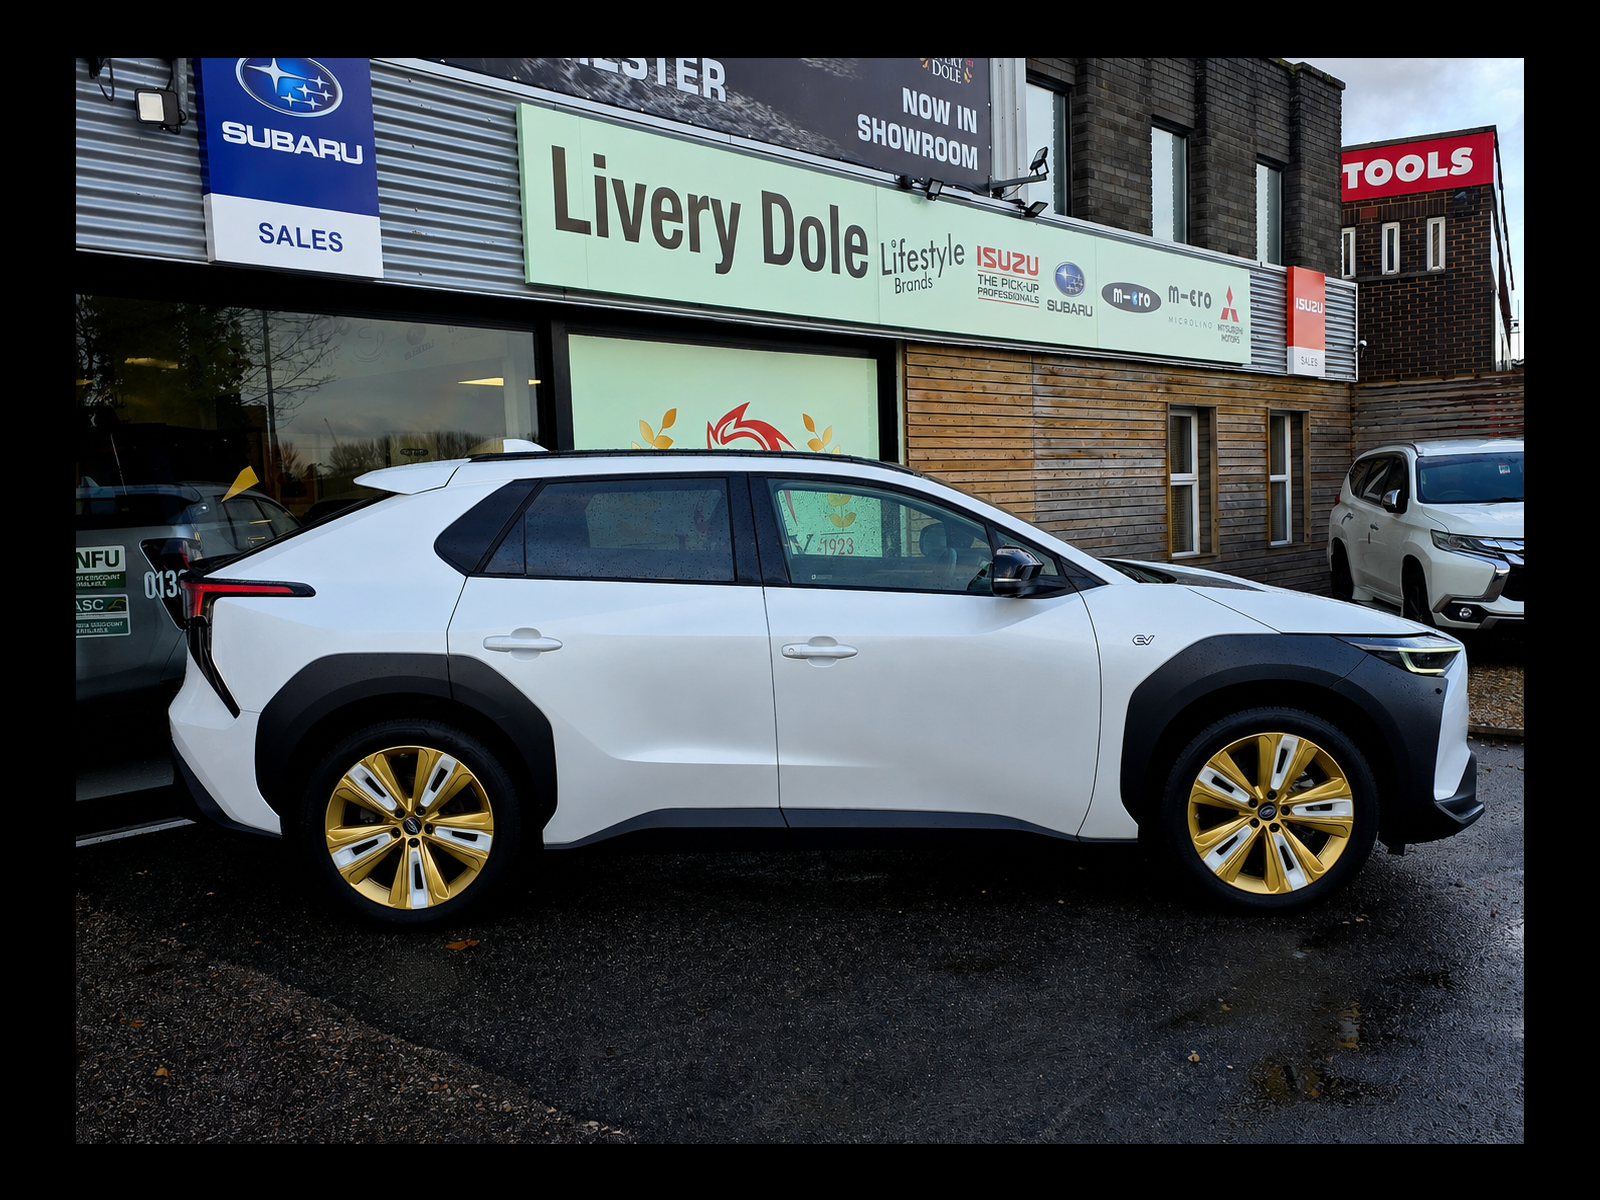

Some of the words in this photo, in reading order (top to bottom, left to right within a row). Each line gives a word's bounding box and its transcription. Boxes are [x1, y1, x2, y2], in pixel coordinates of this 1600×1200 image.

[577, 58, 728, 103] STER
[932, 59, 962, 84] DOLE
[902, 87, 951, 126] NOW
[957, 105, 978, 134] IN
[222, 120, 364, 165] SUBARU
[857, 113, 979, 171] SHOWROOM
[1342, 147, 1474, 189] TOOLS
[551, 145, 742, 275] Livery
[761, 190, 869, 279] Dole
[258, 222, 344, 253] SALES
[880, 233, 965, 278] Lifestyle
[977, 245, 1039, 277] ISUZU
[894, 272, 934, 294] Brands
[977, 274, 998, 287] THE
[1001, 277, 1040, 294] PICK-UP
[977, 286, 1040, 304] PROFESSIONALS
[1295, 297, 1324, 314] ISUZU
[1047, 299, 1093, 317] SUBARU
[1168, 316, 1213, 330] MICROLINO
[1300, 356, 1319, 367] SALES
[820, 537, 854, 555] 1923
[76, 549, 120, 570] NFU
[1132, 634, 1155, 646] EV
